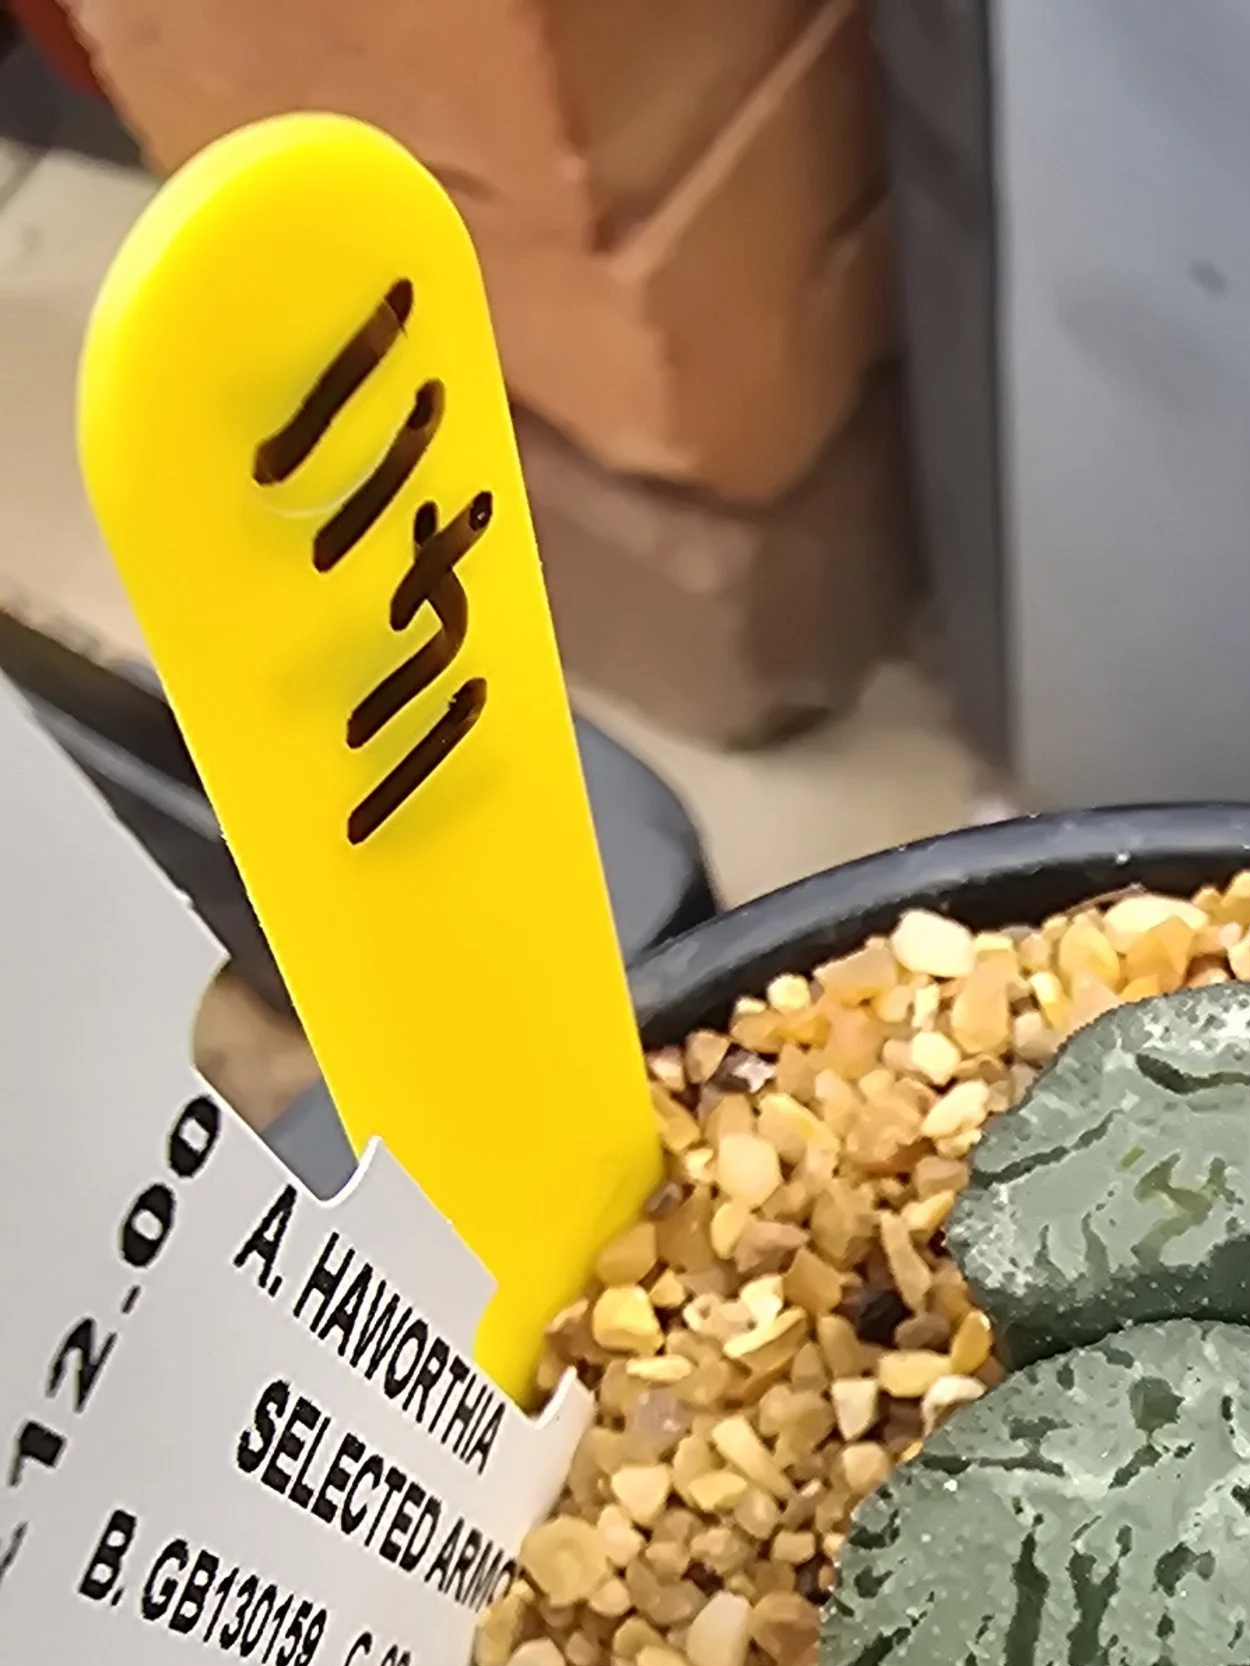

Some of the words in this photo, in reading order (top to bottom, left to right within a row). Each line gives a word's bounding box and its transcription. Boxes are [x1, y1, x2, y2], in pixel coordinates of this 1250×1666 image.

[233, 1184, 297, 1297] A.
[293, 1231, 506, 1476] HAWORTHIA
[78, 1508, 138, 1606] B.
[236, 1379, 442, 1573] SELECTED
